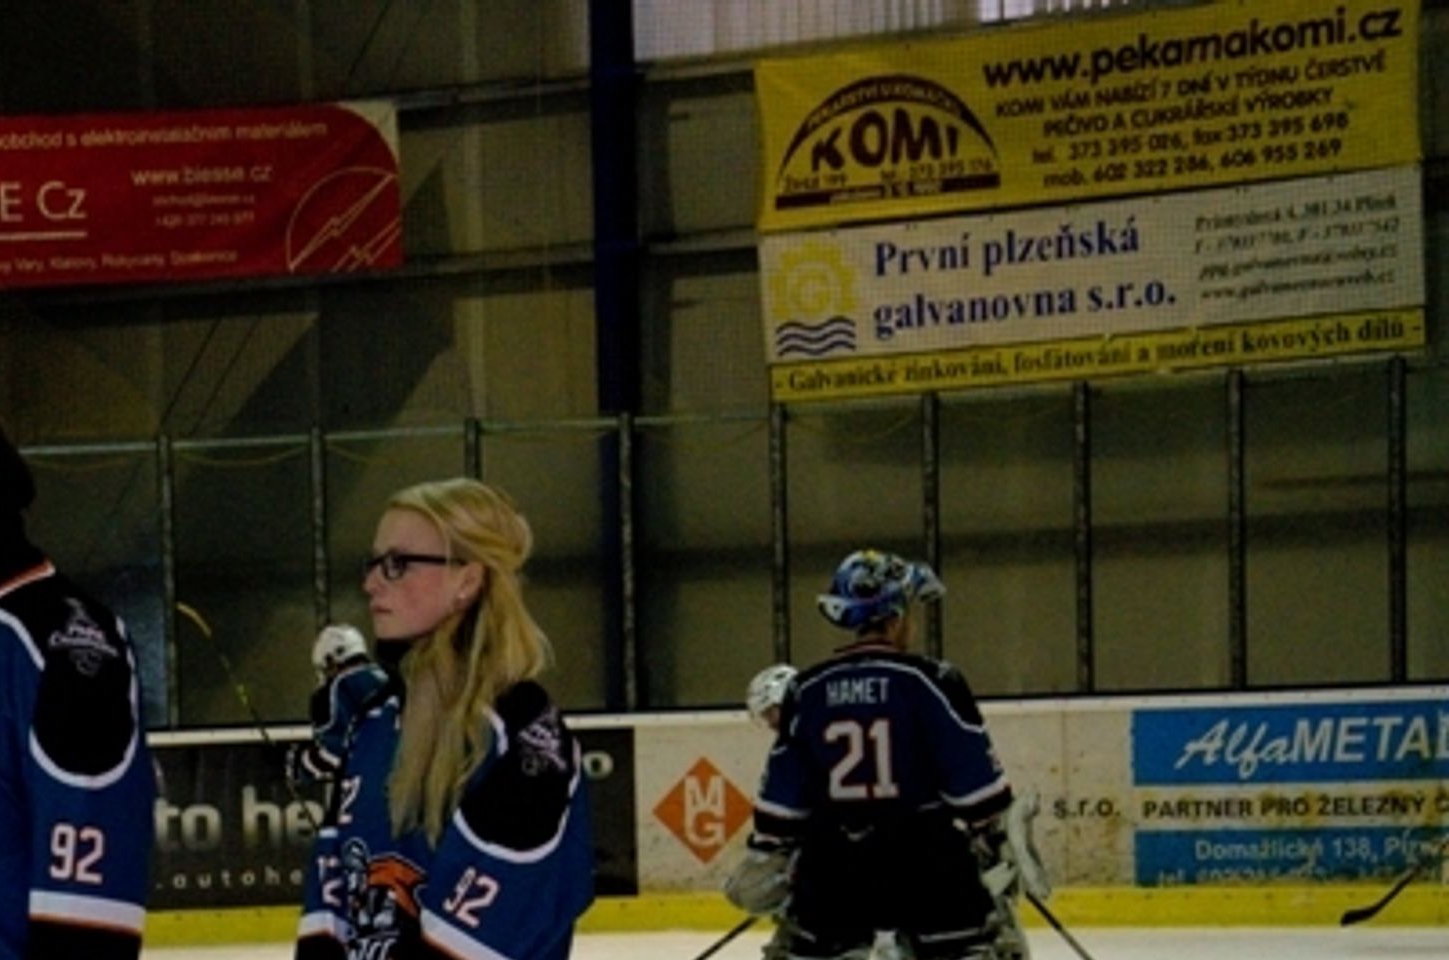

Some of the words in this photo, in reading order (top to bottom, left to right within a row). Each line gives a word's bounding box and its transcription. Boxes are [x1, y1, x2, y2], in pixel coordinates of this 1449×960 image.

[1160, 82, 1171, 98] 7
[1217, 75, 1229, 90] V
[811, 107, 957, 171] KOMI
[1112, 112, 1125, 129] A
[874, 232, 969, 277] První
[983, 215, 1139, 276] plzeňská
[874, 290, 1076, 340] galvanovna
[1087, 280, 1175, 313] s.r.o.
[1241, 321, 1348, 351] kovových
[821, 716, 902, 801] 21
[1053, 799, 1121, 819] s.r.o.
[1144, 797, 1251, 820] PARTNER
[1260, 797, 1310, 818] PRO
[1317, 789, 1425, 816] ŽELEZNÝ
[49, 822, 104, 884] 92
